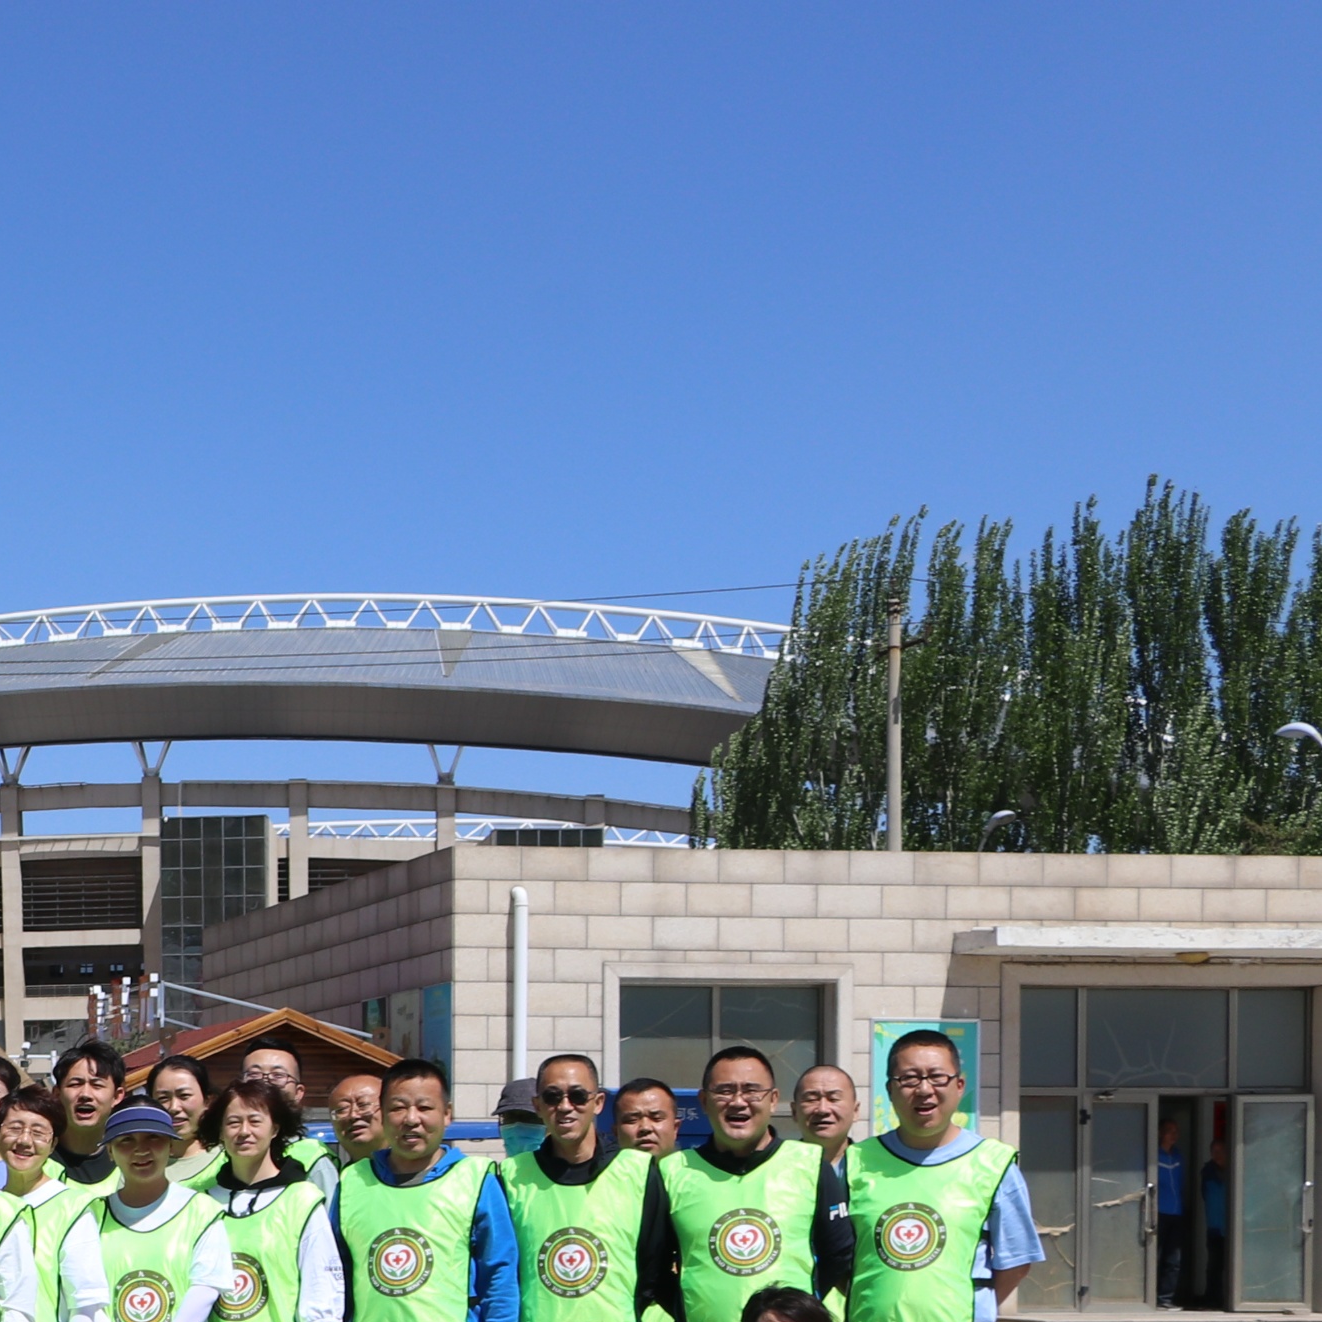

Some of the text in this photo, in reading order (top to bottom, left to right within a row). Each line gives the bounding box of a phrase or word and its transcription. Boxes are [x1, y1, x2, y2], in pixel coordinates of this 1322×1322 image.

[829, 1202, 848, 1221] FIL
[714, 1256, 726, 1268] BAO
[726, 1265, 738, 1273] TOU
[755, 1250, 778, 1272] HOSPITAL
[914, 1247, 942, 1268] HOSPITAL
